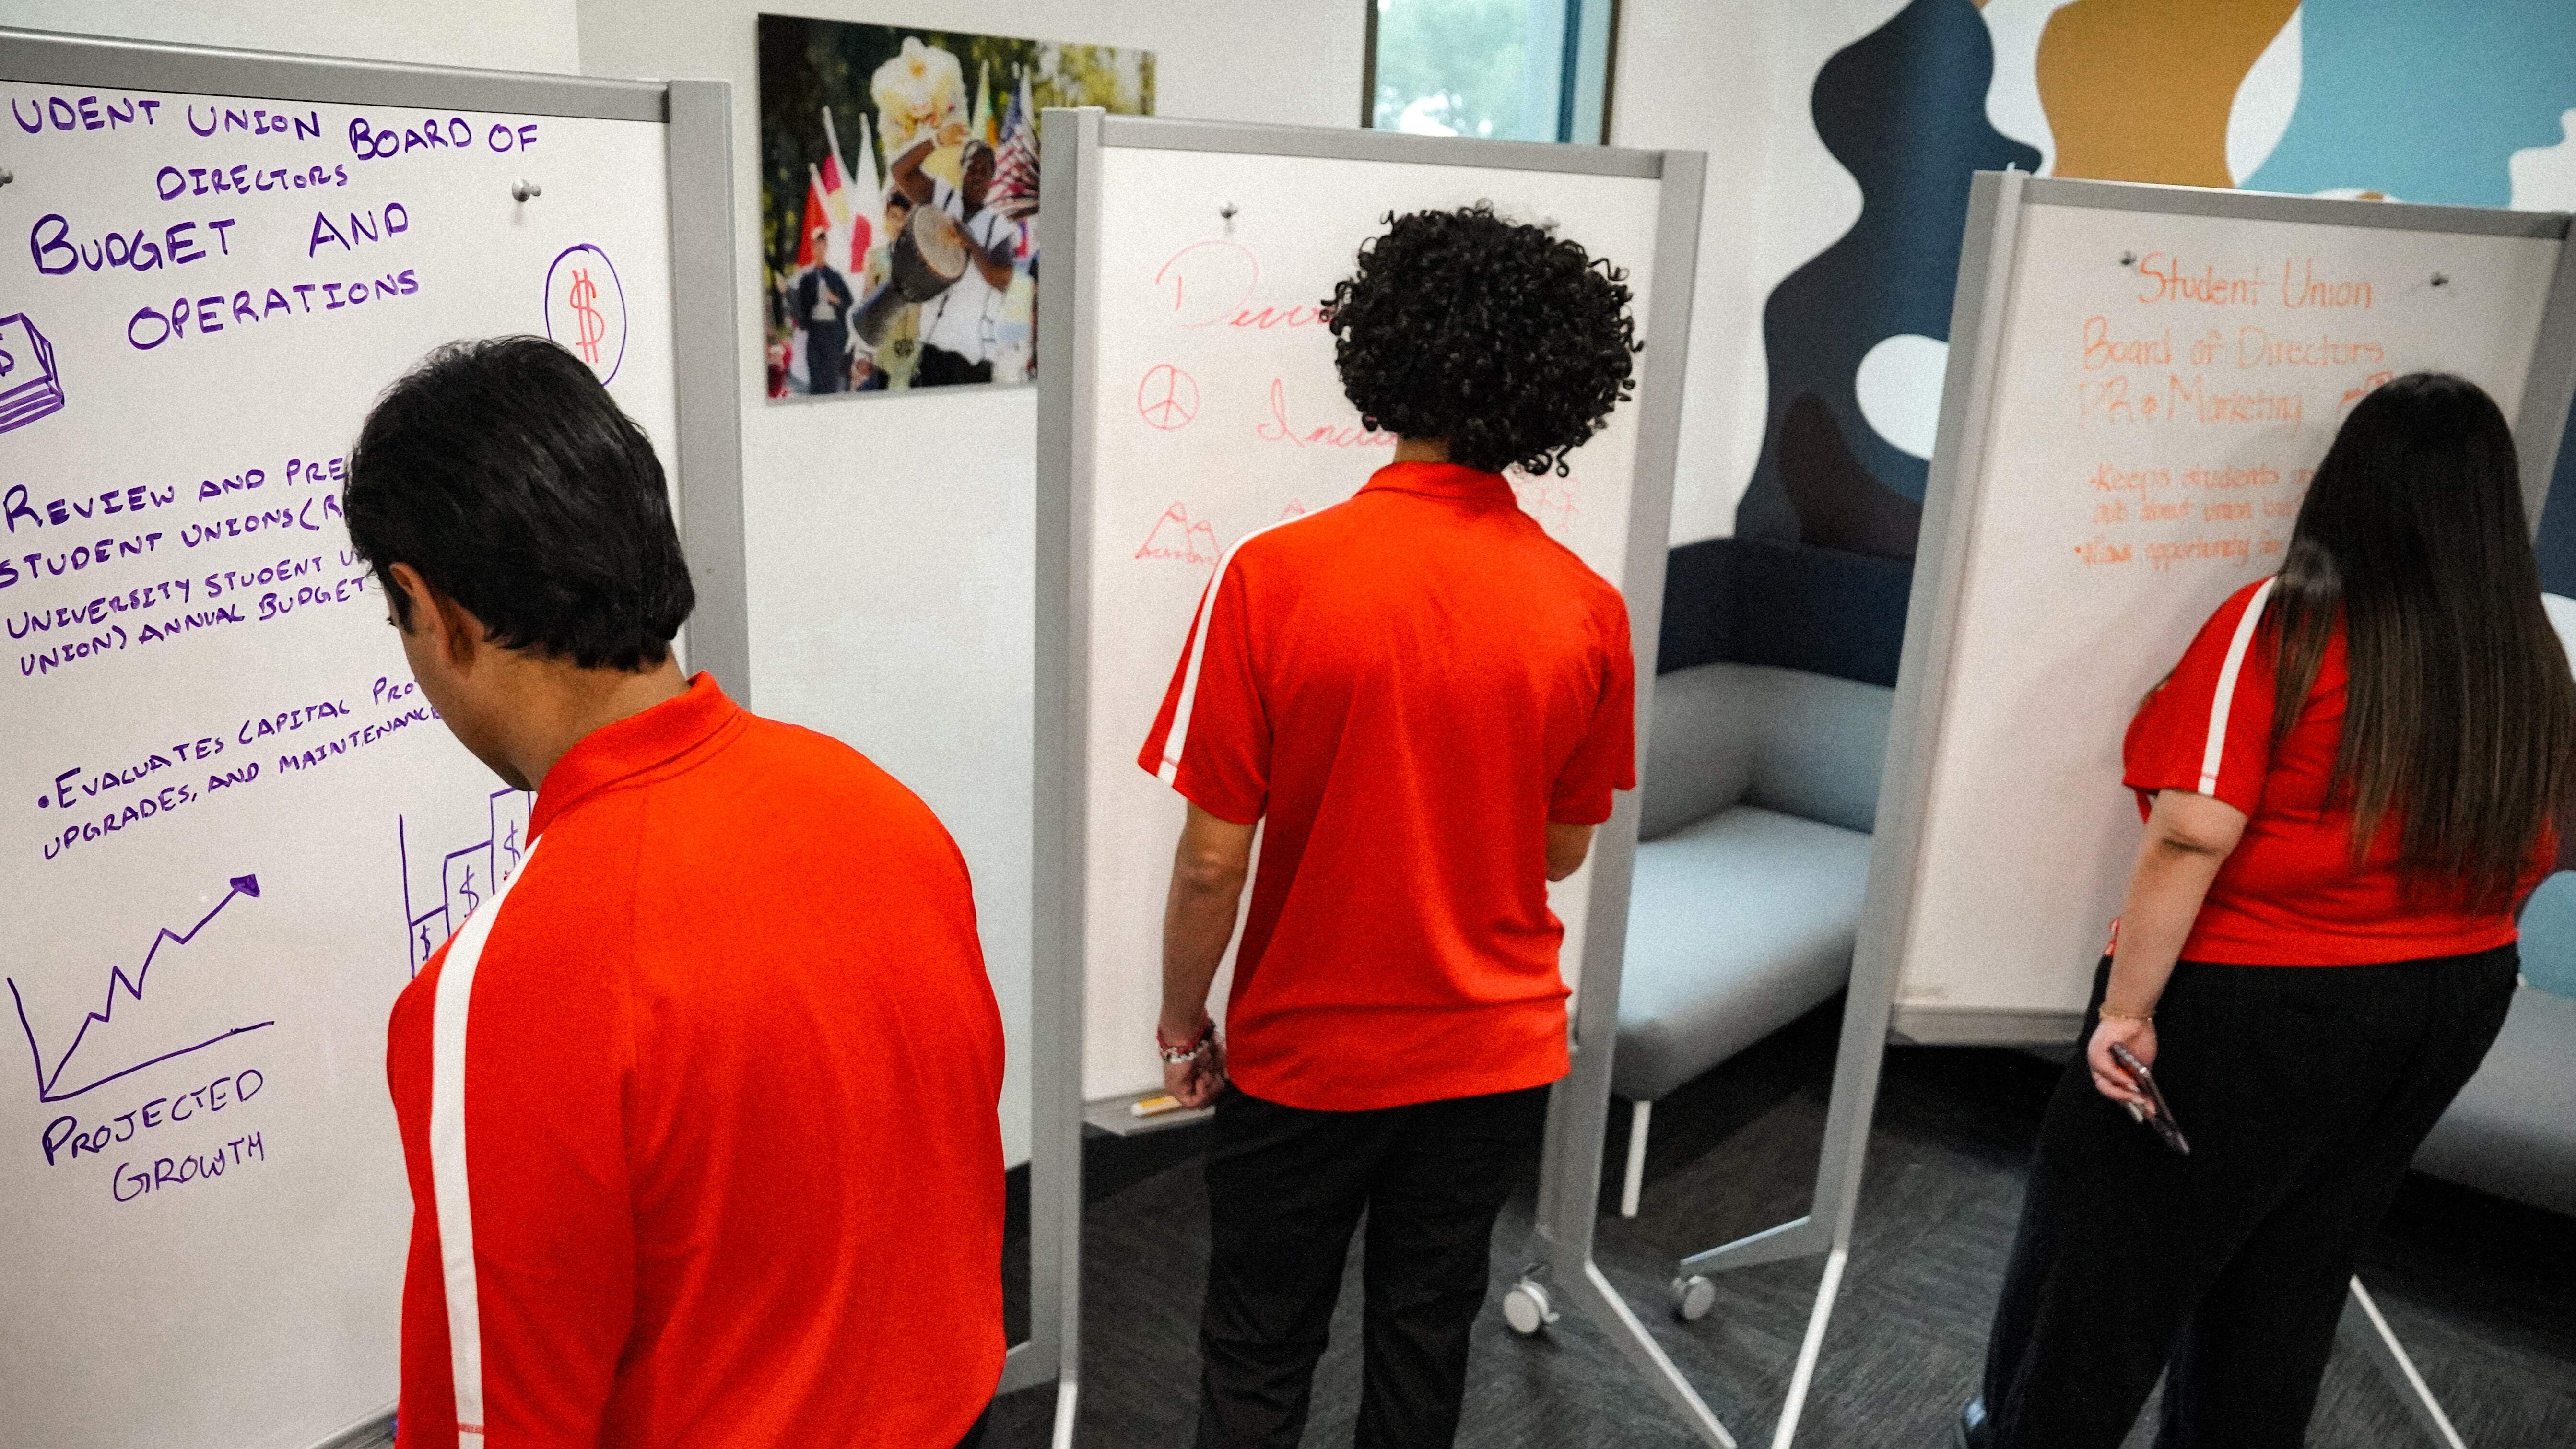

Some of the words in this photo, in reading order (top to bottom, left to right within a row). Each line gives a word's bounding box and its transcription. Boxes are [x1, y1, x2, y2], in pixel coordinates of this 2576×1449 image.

[12, 96, 160, 134] UDENT
[188, 106, 320, 141] UNION
[348, 117, 472, 161] BOARD
[488, 123, 537, 153] OF
[156, 163, 348, 201] DIRECTORS
[30, 213, 235, 275] BUDGET
[309, 202, 409, 258] AND
[127, 269, 419, 351] OPERATIONS
[2138, 250, 2266, 306] Student
[2282, 258, 2373, 309] Union
[2084, 316, 2172, 371] Board
[3, 484, 175, 532] REVIEW
[198, 469, 266, 501] AND
[0, 532, 162, 589] STUDENT
[7, 579, 190, 639] UNIVERSITY
[204, 557, 321, 598] STUDENT
[21, 625, 127, 676] UNION)
[139, 605, 244, 643] ANNUAL
[258, 577, 364, 621] BUDGET
[238, 701, 350, 744] CAPITAL
[43, 788, 196, 859] UPGRADES,
[208, 762, 259, 791] AND
[41, 1069, 262, 1165] PROJECTED
[114, 1133, 262, 1202] GROWTH
